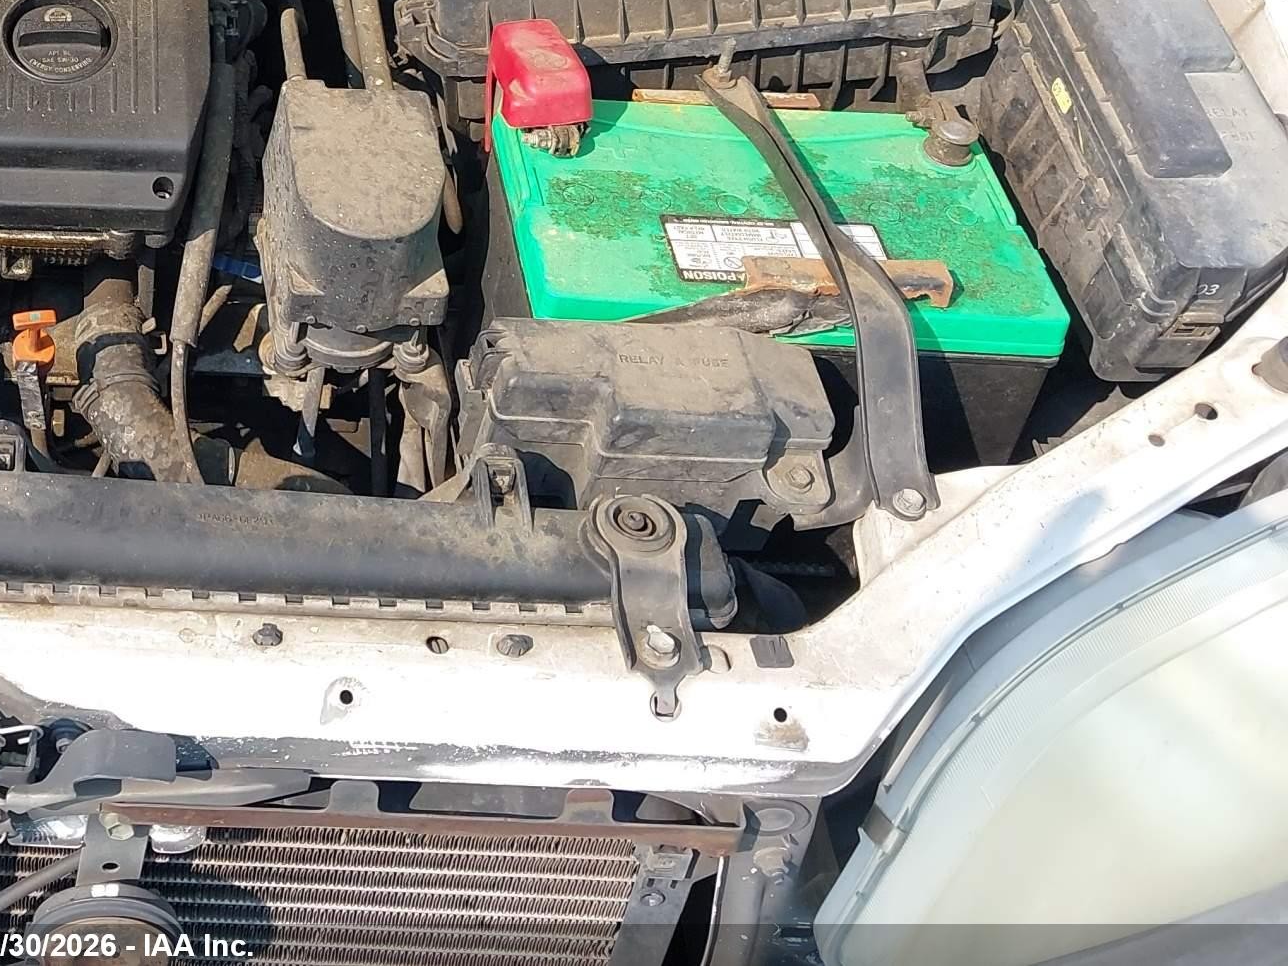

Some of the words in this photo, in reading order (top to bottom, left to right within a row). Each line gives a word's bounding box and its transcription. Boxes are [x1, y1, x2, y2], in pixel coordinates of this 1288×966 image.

[29, 58, 53, 72] ENERGY
[682, 270, 738, 282] POISON
[618, 353, 665, 365] RELAY
